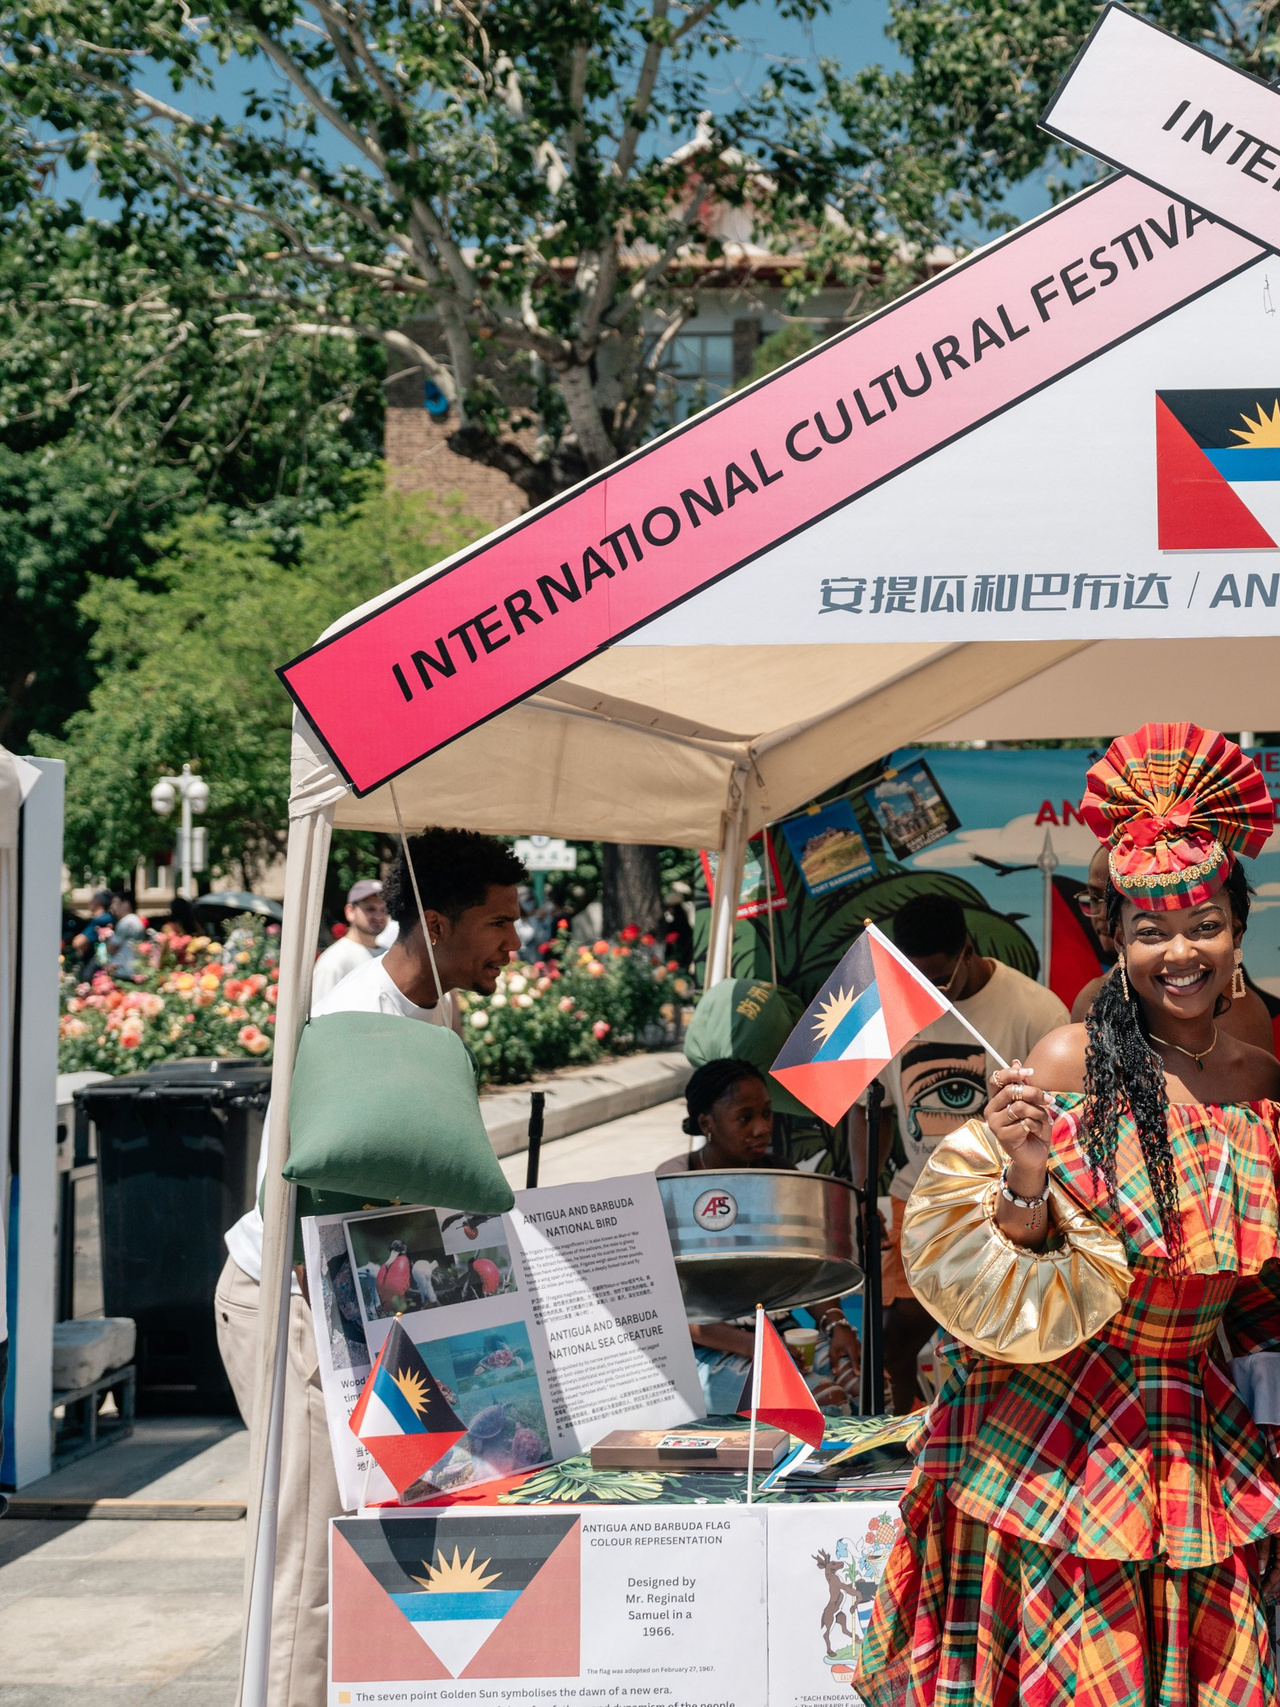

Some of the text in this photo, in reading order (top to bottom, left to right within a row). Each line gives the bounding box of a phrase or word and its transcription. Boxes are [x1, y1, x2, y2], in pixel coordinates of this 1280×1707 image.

[391, 200, 1215, 703] INTERNATIONAL CULTURAL FESTIVA
[818, 573, 1172, 614] 安提瓜和巴布达
[748, 898, 788, 914] DOCKARD
[523, 1198, 634, 1225] ANTIGUA AND BARBUDA
[546, 1216, 618, 1238] NATIONAL BIRD
[549, 1309, 659, 1342] ANTIGUA AND BARBUDA
[548, 1325, 664, 1360] NATIONAL SEA CREATURE
[341, 1376, 366, 1388] Wood
[582, 1520, 731, 1532] ANTIGUA AND BARBUDA FLAG
[590, 1535, 723, 1547] COLOUR REPRESENTATION
[627, 1575, 696, 1590] Designed by
[625, 1592, 694, 1605] Mr. Reginald
[627, 1609, 692, 1620] Samuel in a
[642, 1626, 674, 1636] 1966.
[355, 1692, 375, 1701] The
[409, 1690, 438, 1702] point
[439, 1690, 476, 1699] Golden
[478, 1689, 498, 1698] Sun
[500, 1688, 557, 1700] symbolises
[559, 1688, 576, 1697] the
[578, 1687, 606, 1696] dawn
[608, 1687, 620, 1696] of
